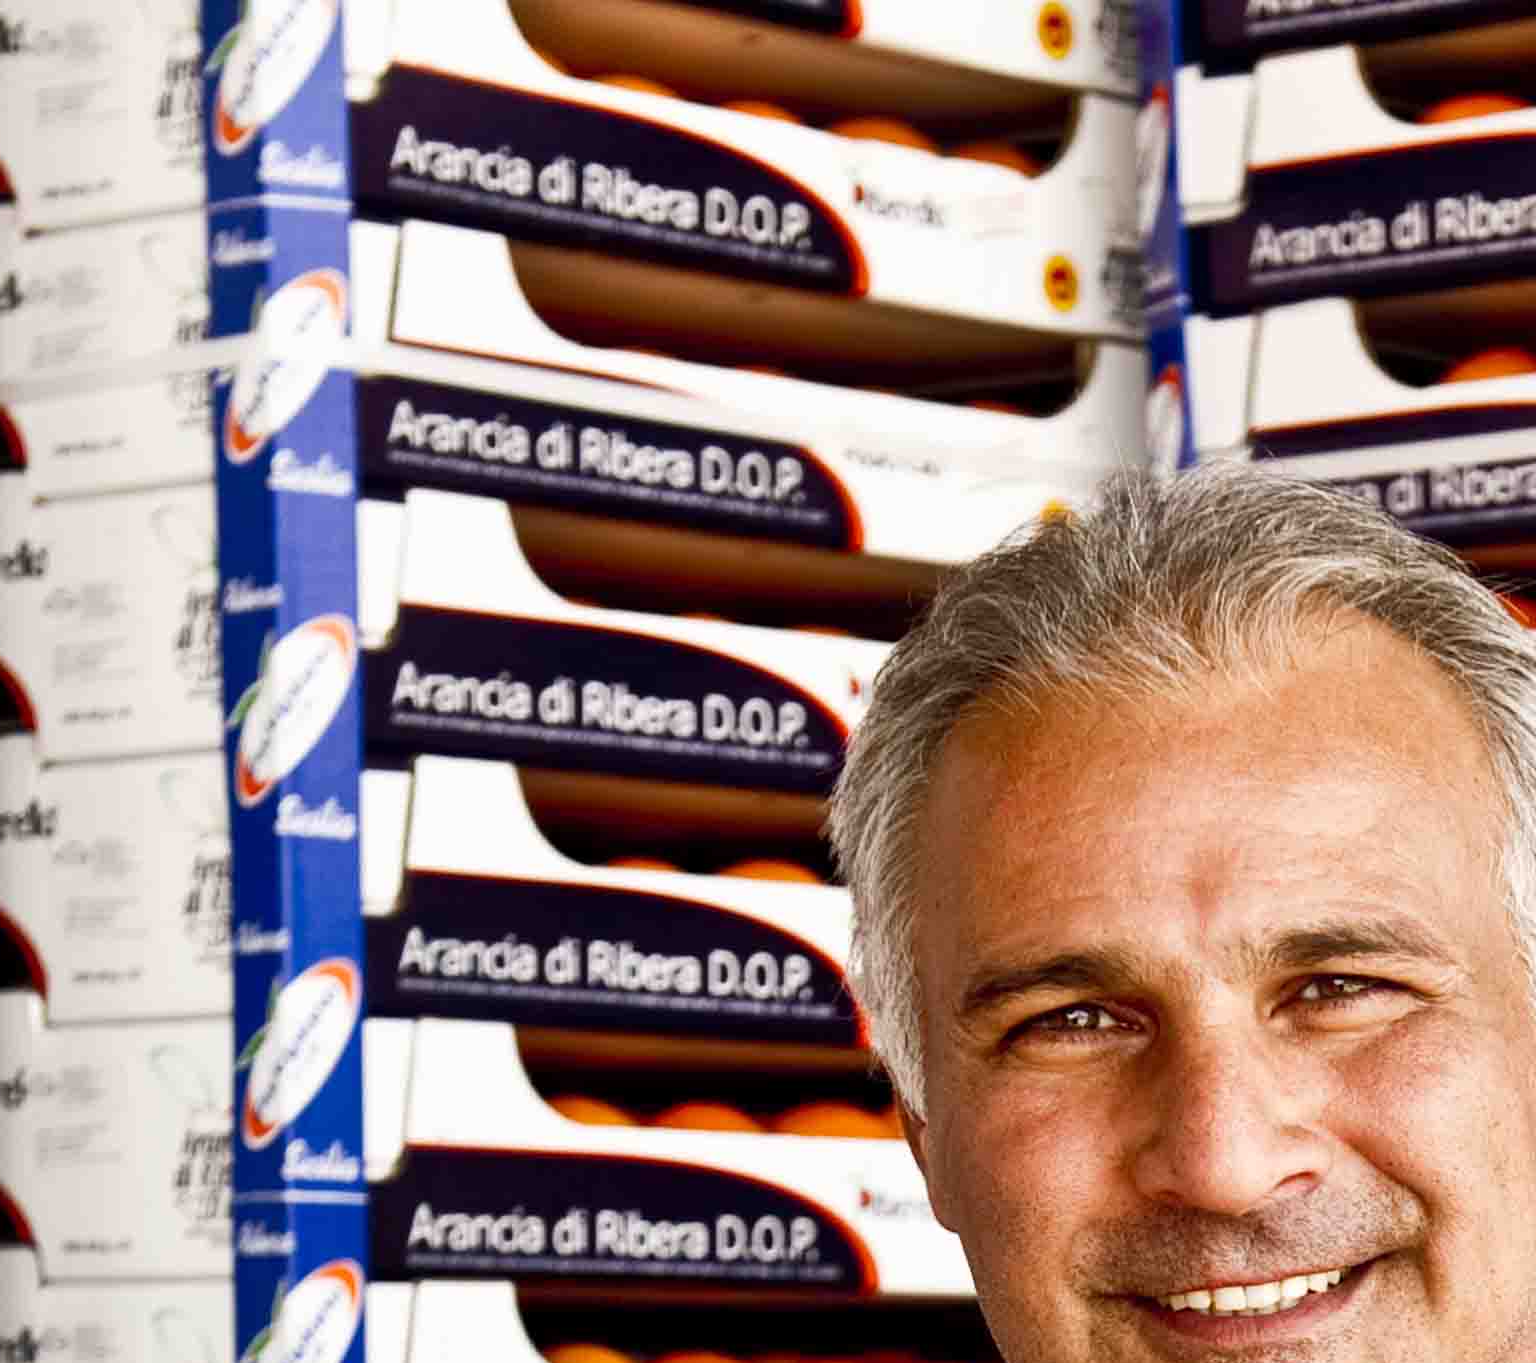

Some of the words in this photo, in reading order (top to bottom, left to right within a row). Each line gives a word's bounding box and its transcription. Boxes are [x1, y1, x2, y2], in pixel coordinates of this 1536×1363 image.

[392, 661, 532, 721] Arancia
[538, 679, 574, 724] di
[582, 680, 697, 738] Ribera
